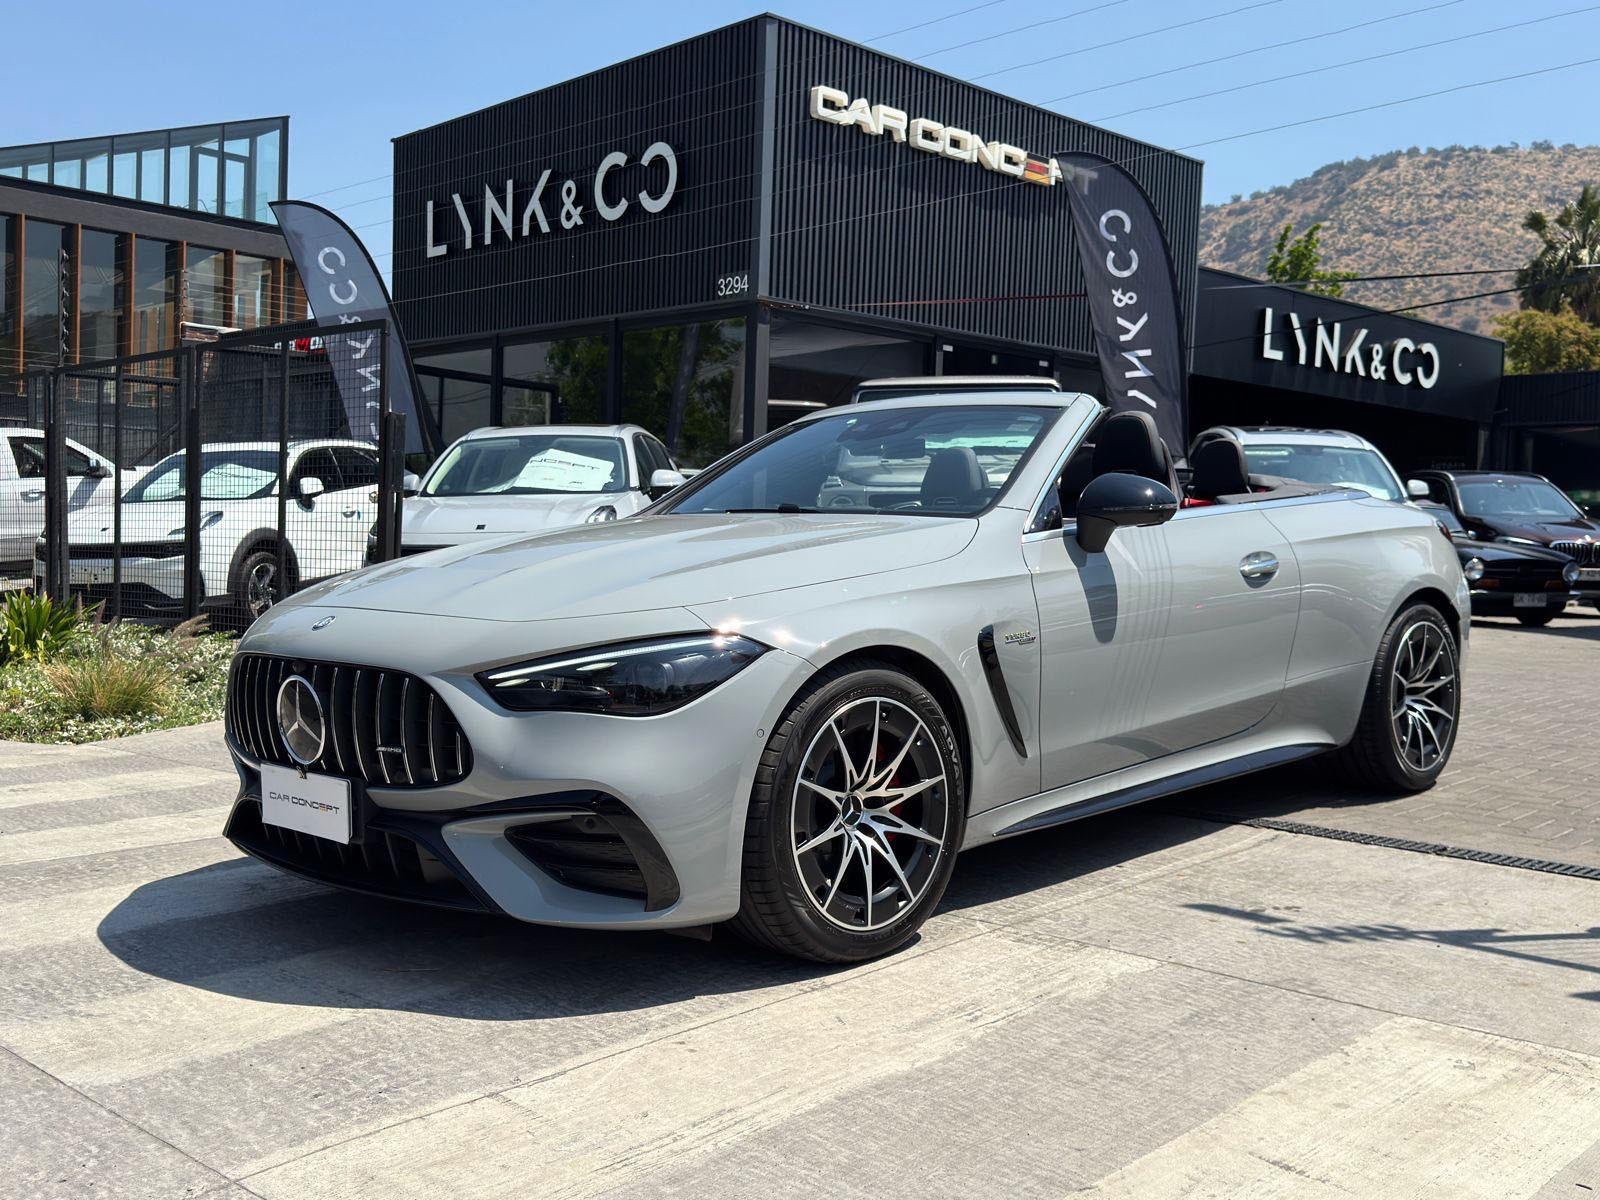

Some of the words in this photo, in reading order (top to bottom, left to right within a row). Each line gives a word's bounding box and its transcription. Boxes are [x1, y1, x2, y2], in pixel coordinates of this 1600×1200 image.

[809, 85, 908, 143] CAR
[717, 274, 749, 297] 3294
[269, 791, 290, 803] CAR
[291, 796, 340, 815] CONCEPT
